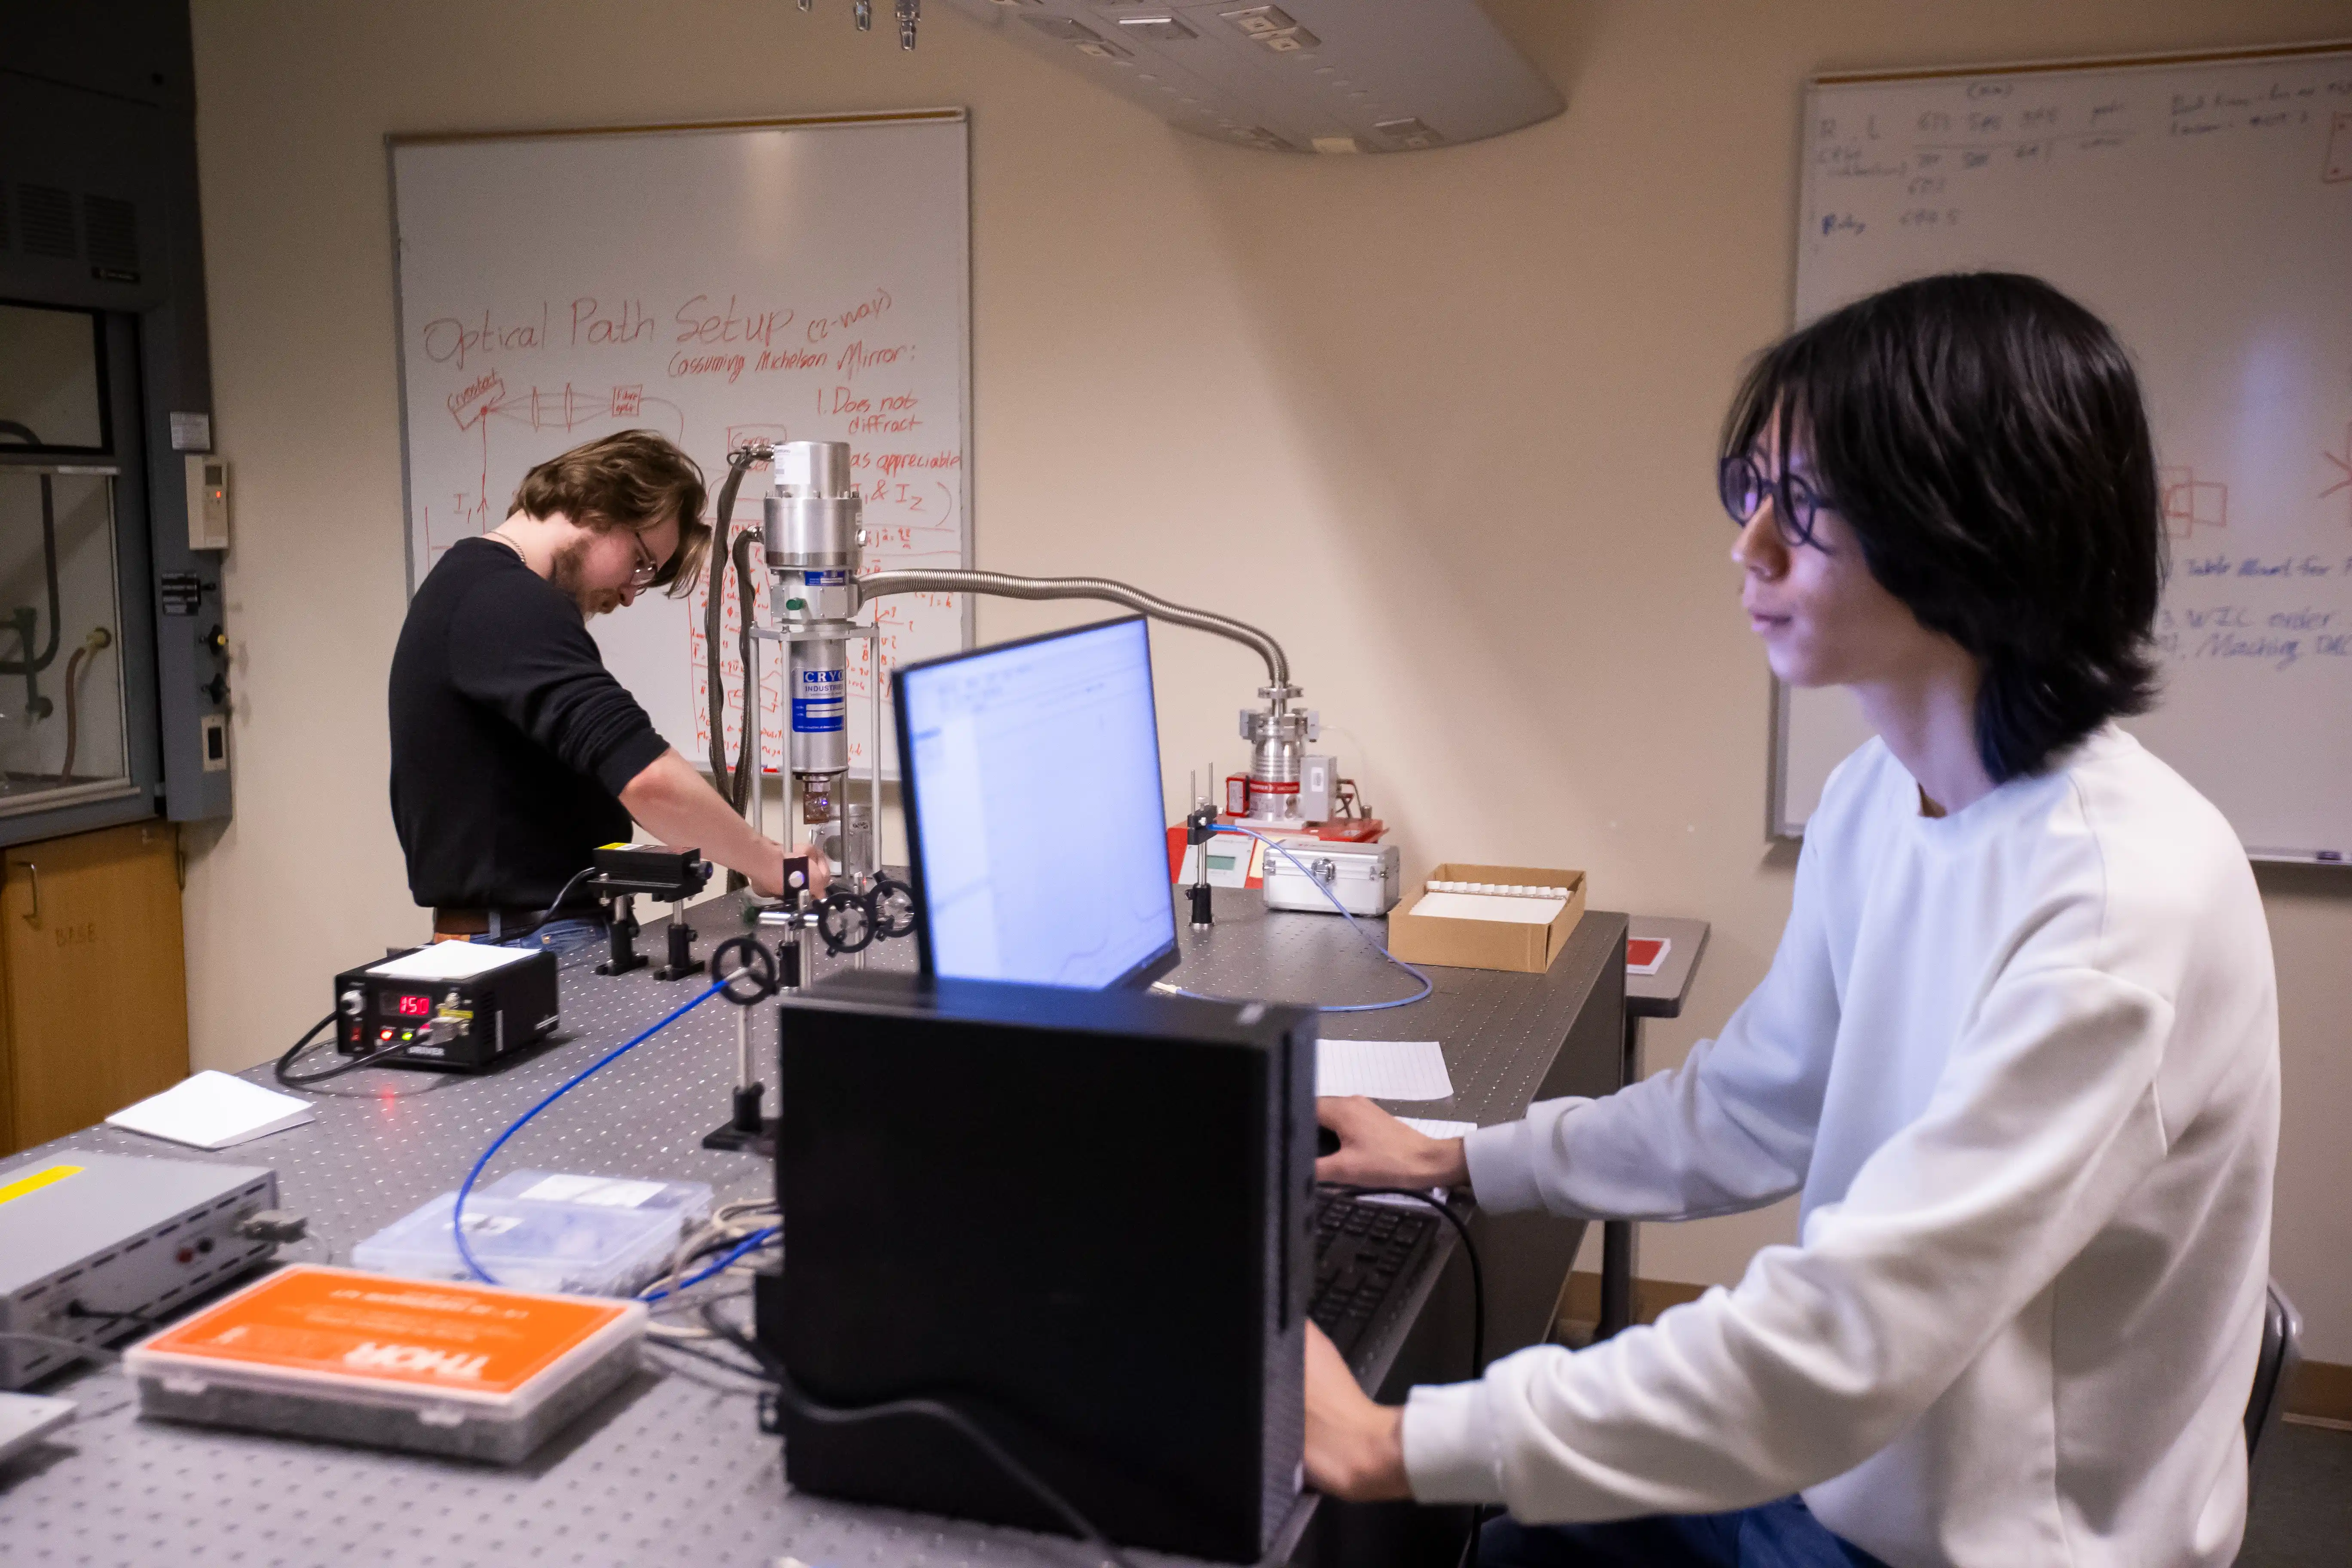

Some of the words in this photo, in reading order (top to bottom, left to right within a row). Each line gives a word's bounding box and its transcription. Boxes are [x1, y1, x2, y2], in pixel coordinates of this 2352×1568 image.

[423, 300, 547, 371] Optical
[571, 297, 655, 346] Path
[676, 294, 795, 346] Setup
[755, 347, 827, 372] Michelson
[832, 386, 871, 415] Does
[879, 389, 919, 412] not
[848, 413, 923, 434] diffract
[876, 449, 961, 479] appreciable
[871, 479, 888, 500] &
[399, 995, 430, 1016] 150
